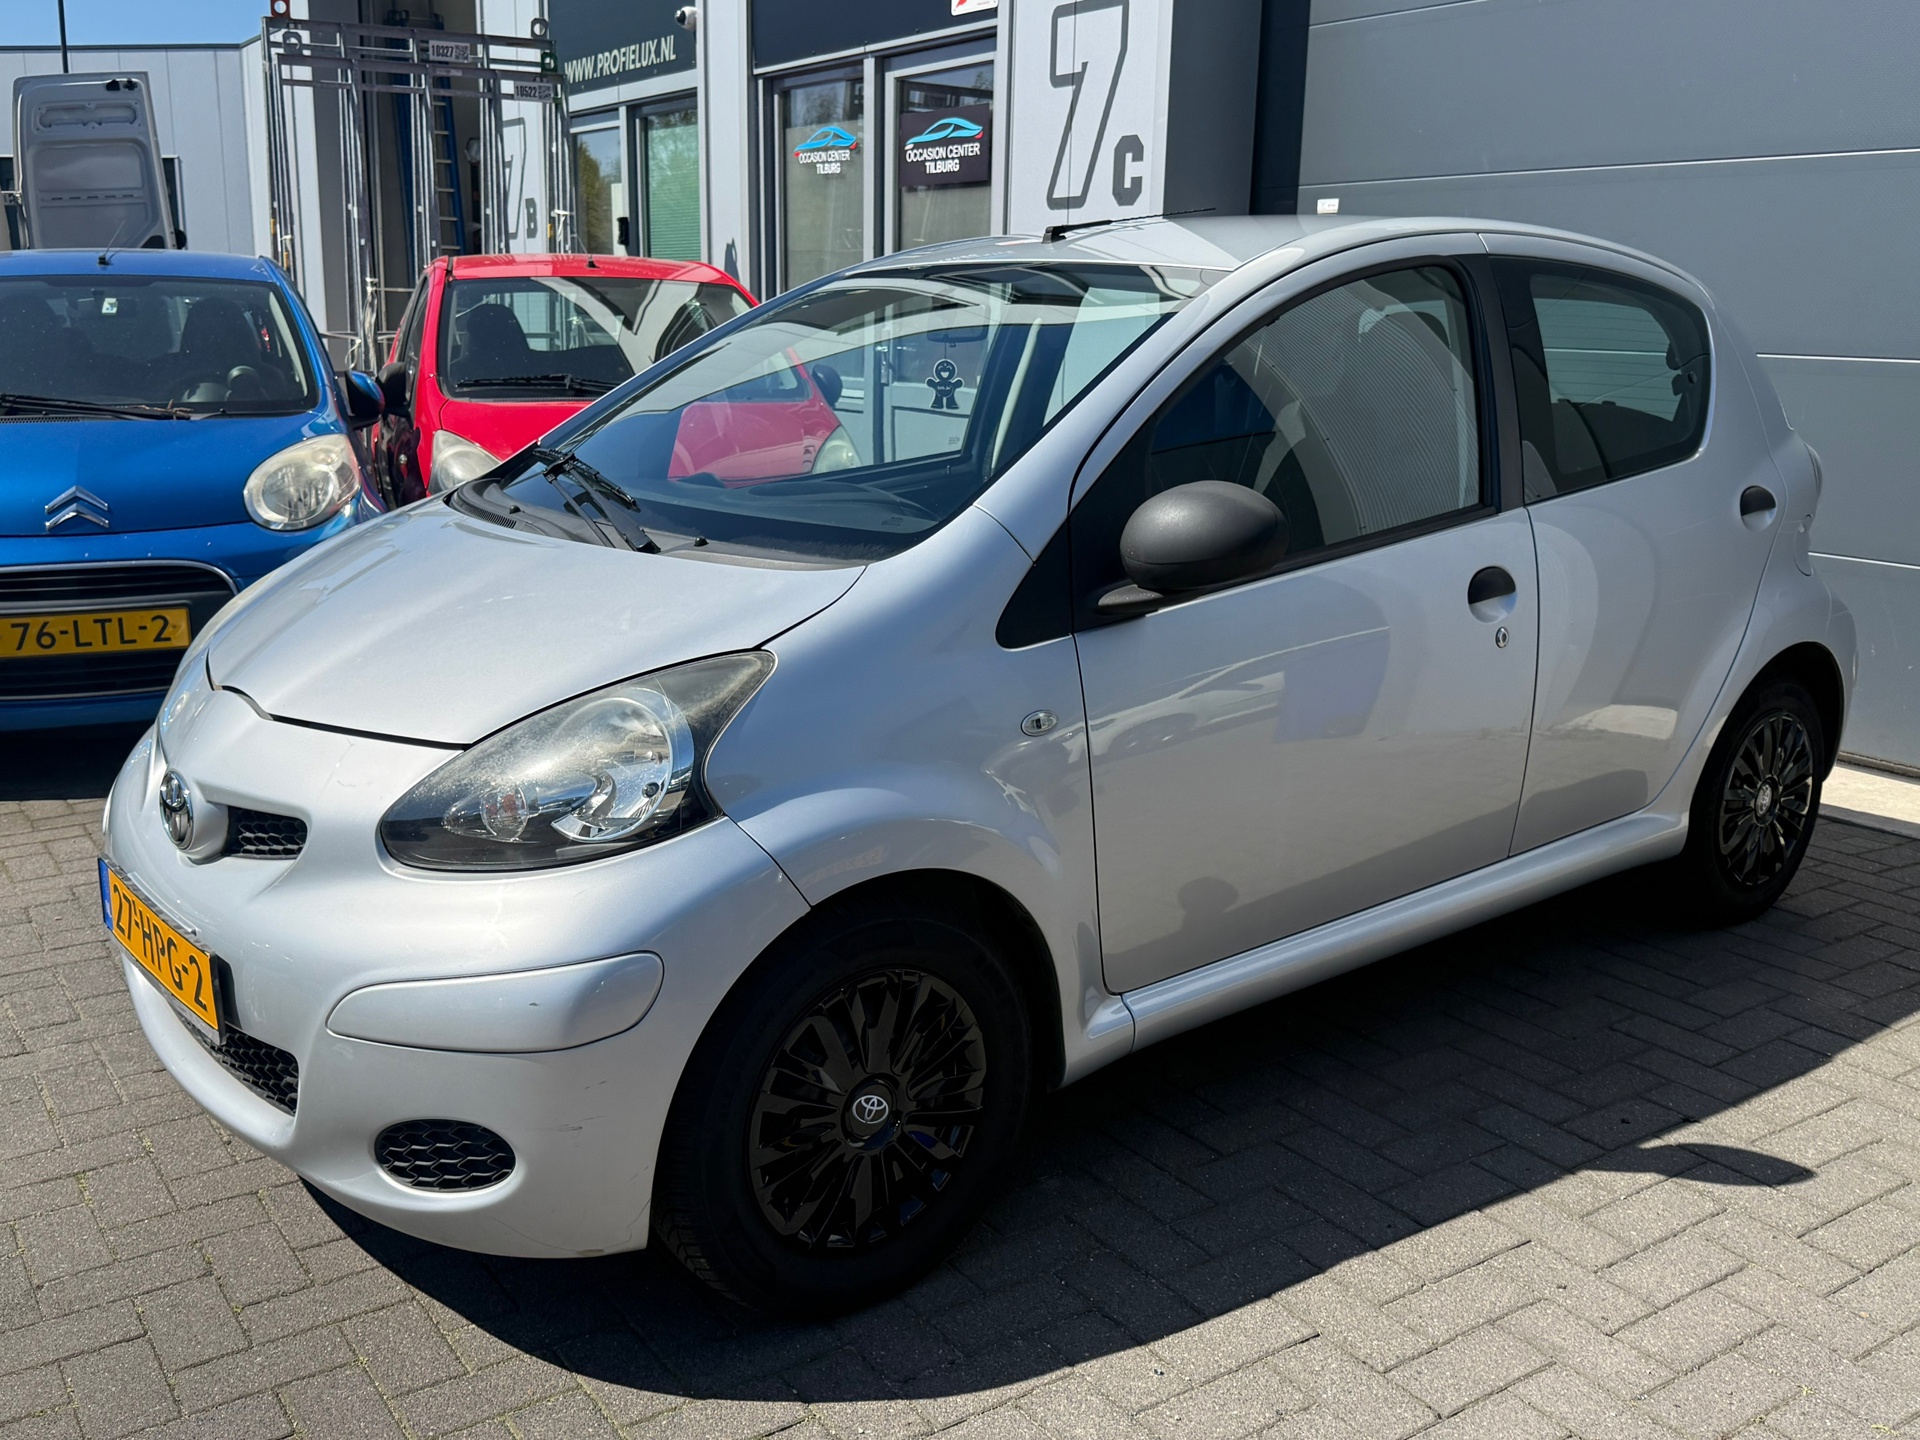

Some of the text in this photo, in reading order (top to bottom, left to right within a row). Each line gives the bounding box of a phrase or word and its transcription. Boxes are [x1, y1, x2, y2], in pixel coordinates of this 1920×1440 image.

[431, 44, 455, 58] 10327
[564, 35, 677, 84] WWW.PROFIELUX.NL
[515, 85, 539, 98] 10522
[798, 149, 851, 164] OCCASION CENTER
[905, 142, 981, 163] OCCASION CENTER
[815, 162, 841, 175] TILBURG
[924, 159, 960, 174] TILBURG
[10, 614, 172, 651] 76-LTL-2
[113, 883, 208, 1013] 27-HPG-2
